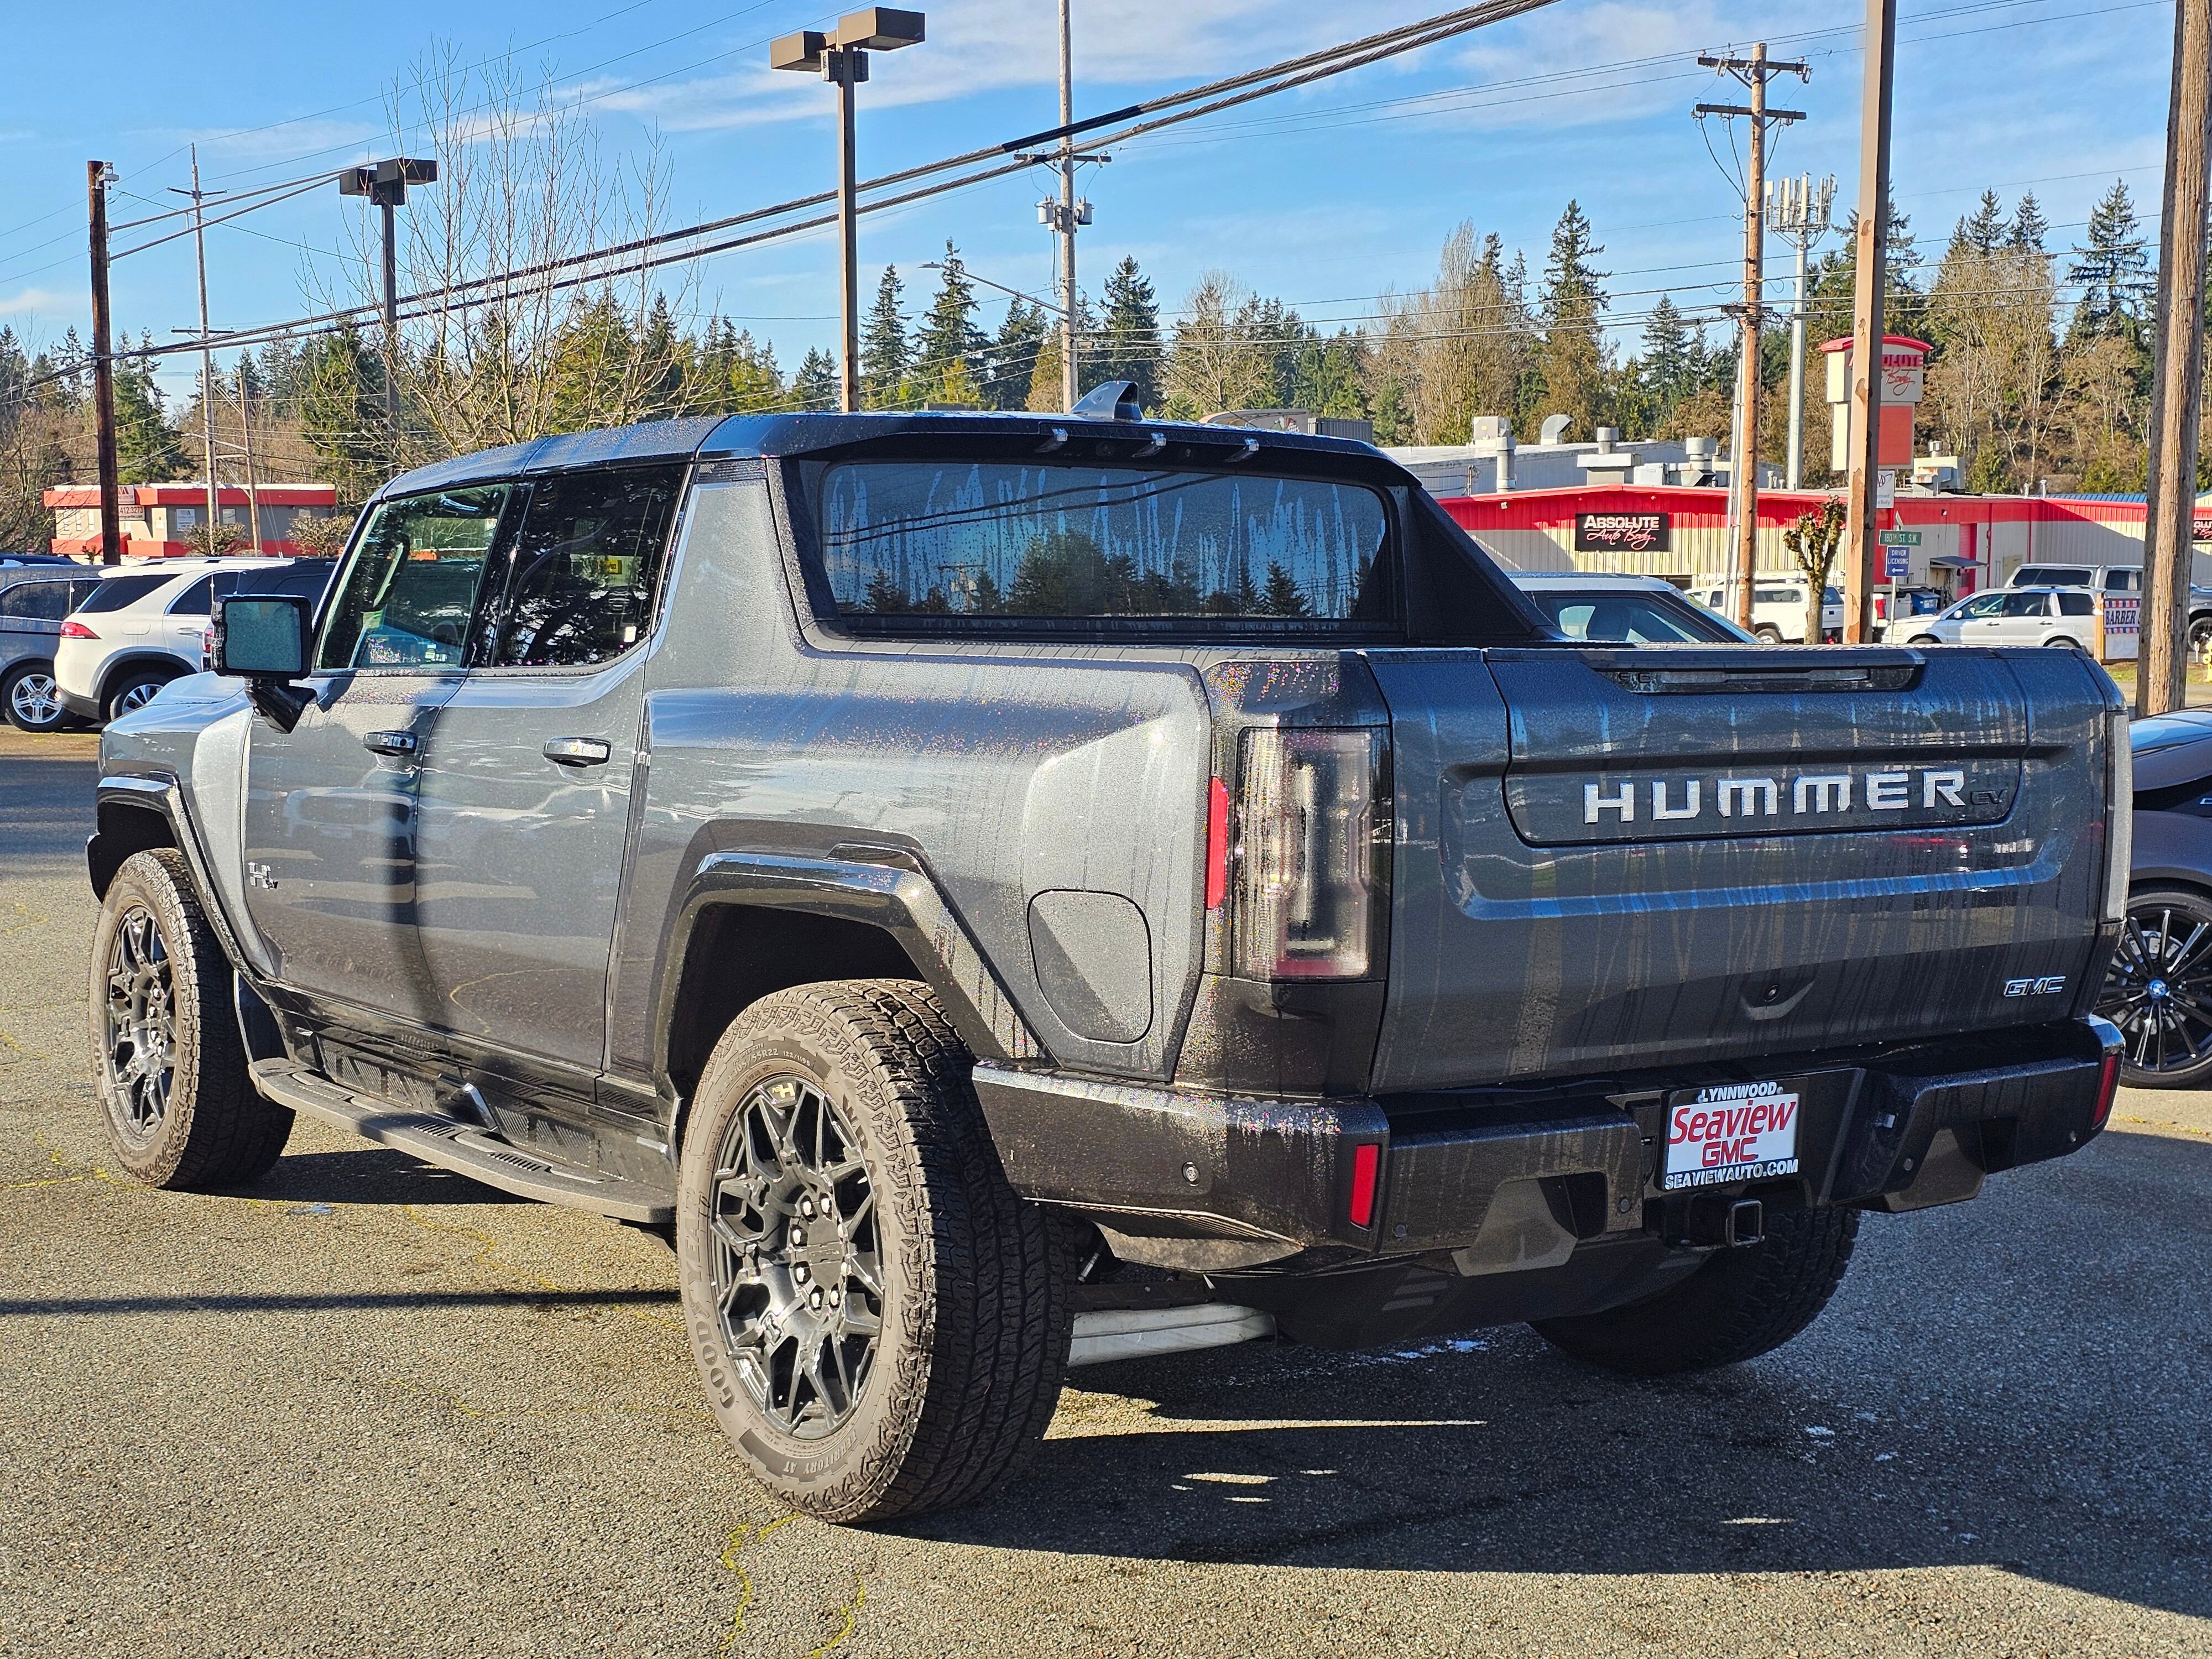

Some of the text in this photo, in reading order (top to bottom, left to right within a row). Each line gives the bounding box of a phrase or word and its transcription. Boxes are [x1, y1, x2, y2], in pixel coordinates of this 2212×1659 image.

[1584, 515, 1660, 529] ABSOLUTE
[1587, 523, 1656, 550] Auto Body
[2106, 610, 2137, 625] BARBER
[1583, 770, 2008, 824] HUMMER EV
[2003, 975, 2066, 997] GMC
[1702, 1082, 1777, 1102] LYNNWOOD
[1669, 1099, 1796, 1144] Seaview
[1702, 1136, 1757, 1167] GMC
[1665, 1159, 1799, 1190] SEAVIEWAUTO.COM
[783, 1460, 797, 1473] AT
